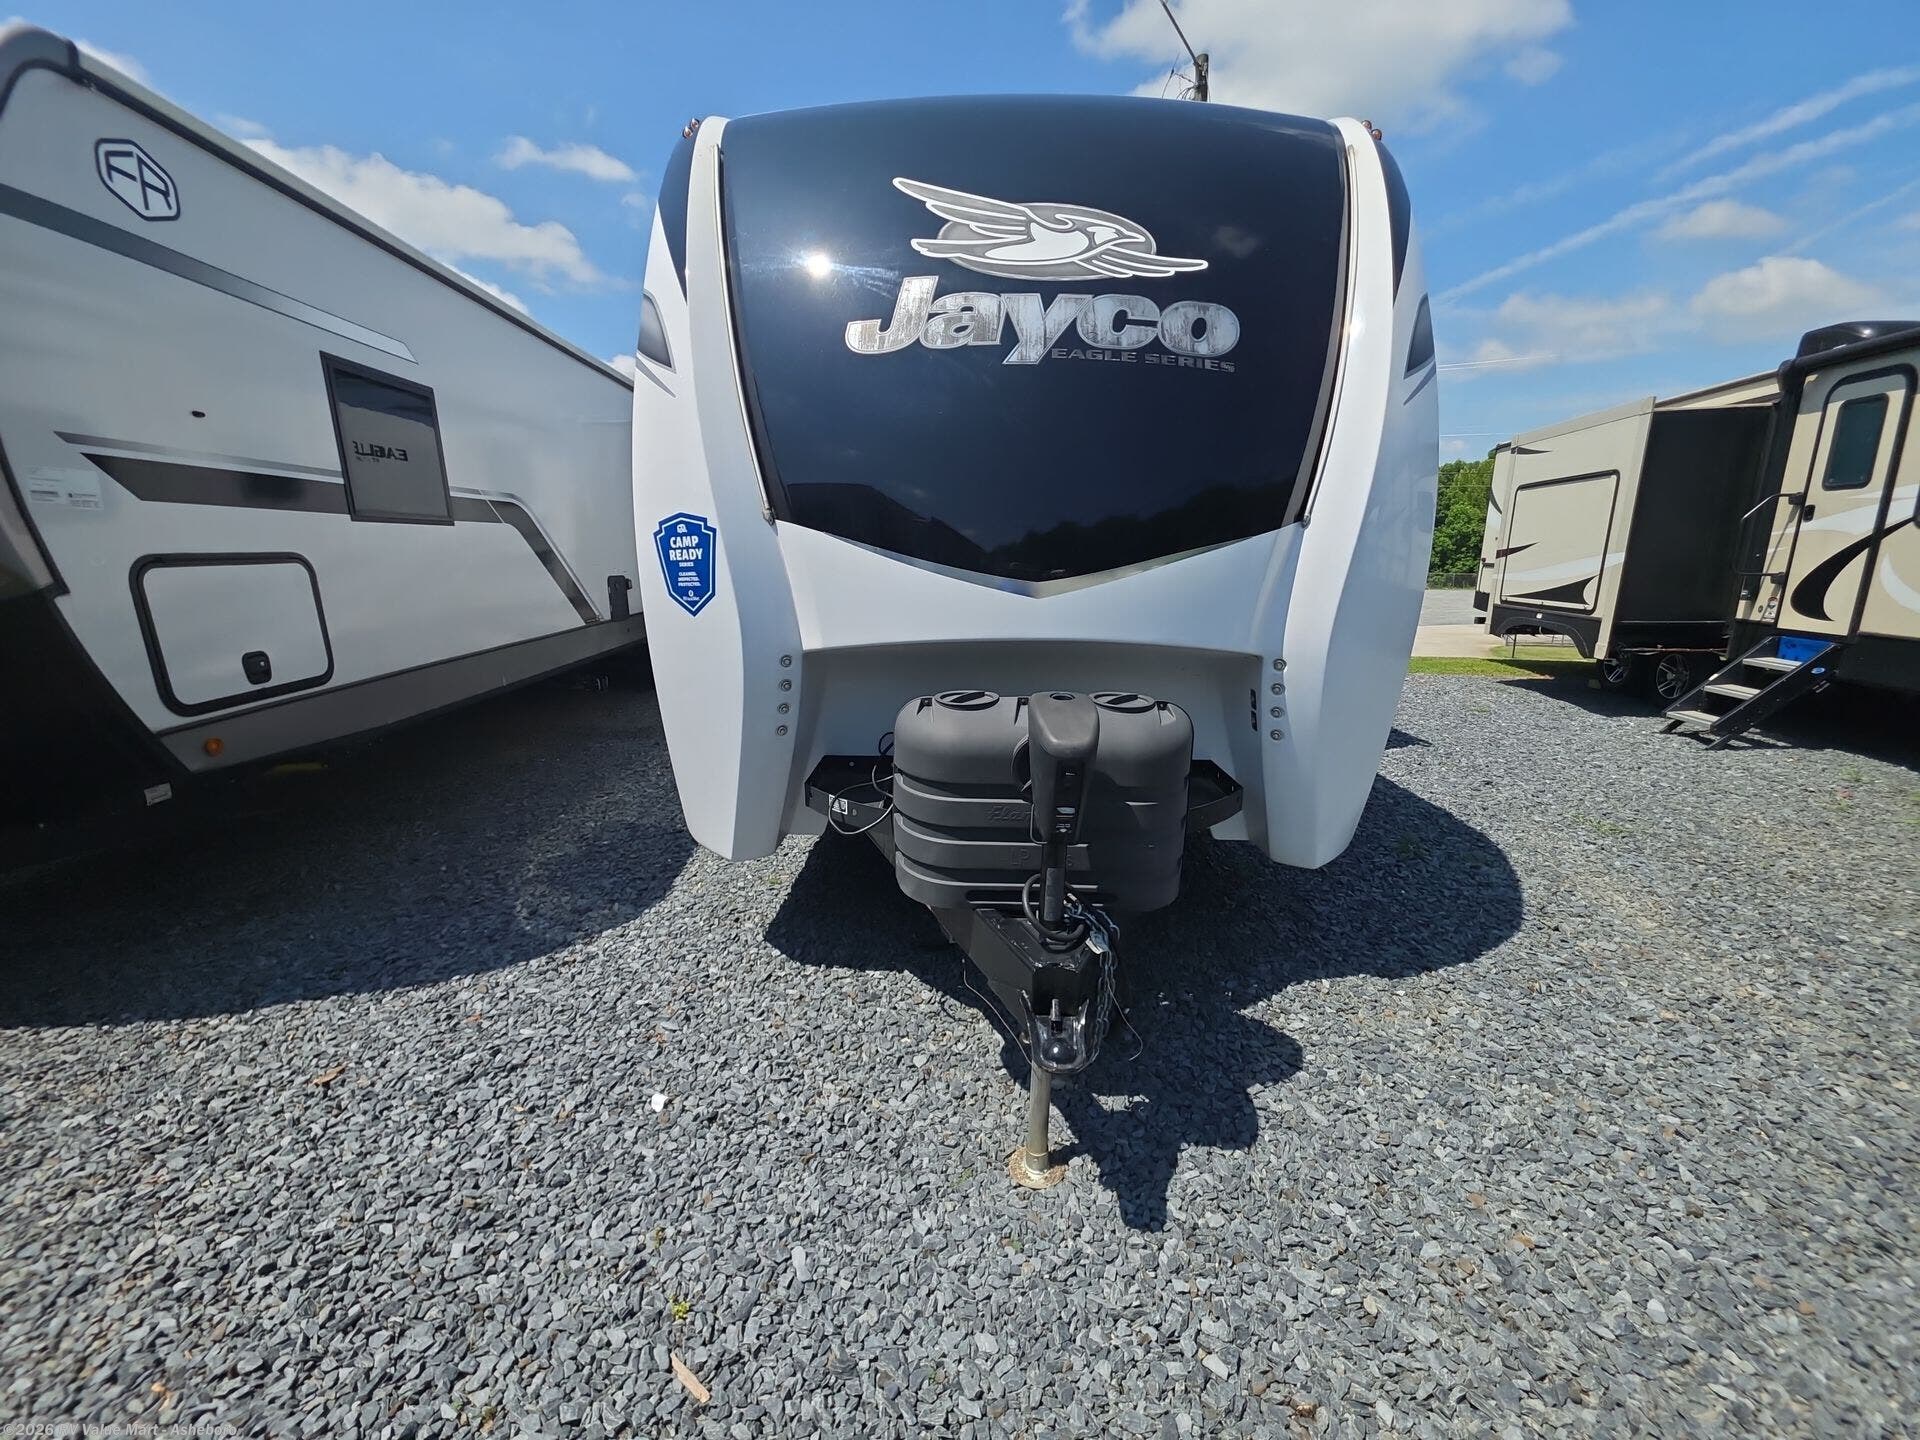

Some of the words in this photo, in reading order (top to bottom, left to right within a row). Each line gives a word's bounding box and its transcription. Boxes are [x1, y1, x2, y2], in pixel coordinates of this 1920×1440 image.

[104, 150, 172, 211] FR
[844, 274, 1241, 365] Jayco
[1051, 348, 1139, 363] EAGLE
[1144, 353, 1236, 373] SERIES
[669, 548, 703, 561] READY
[670, 536, 699, 548] CAMP
